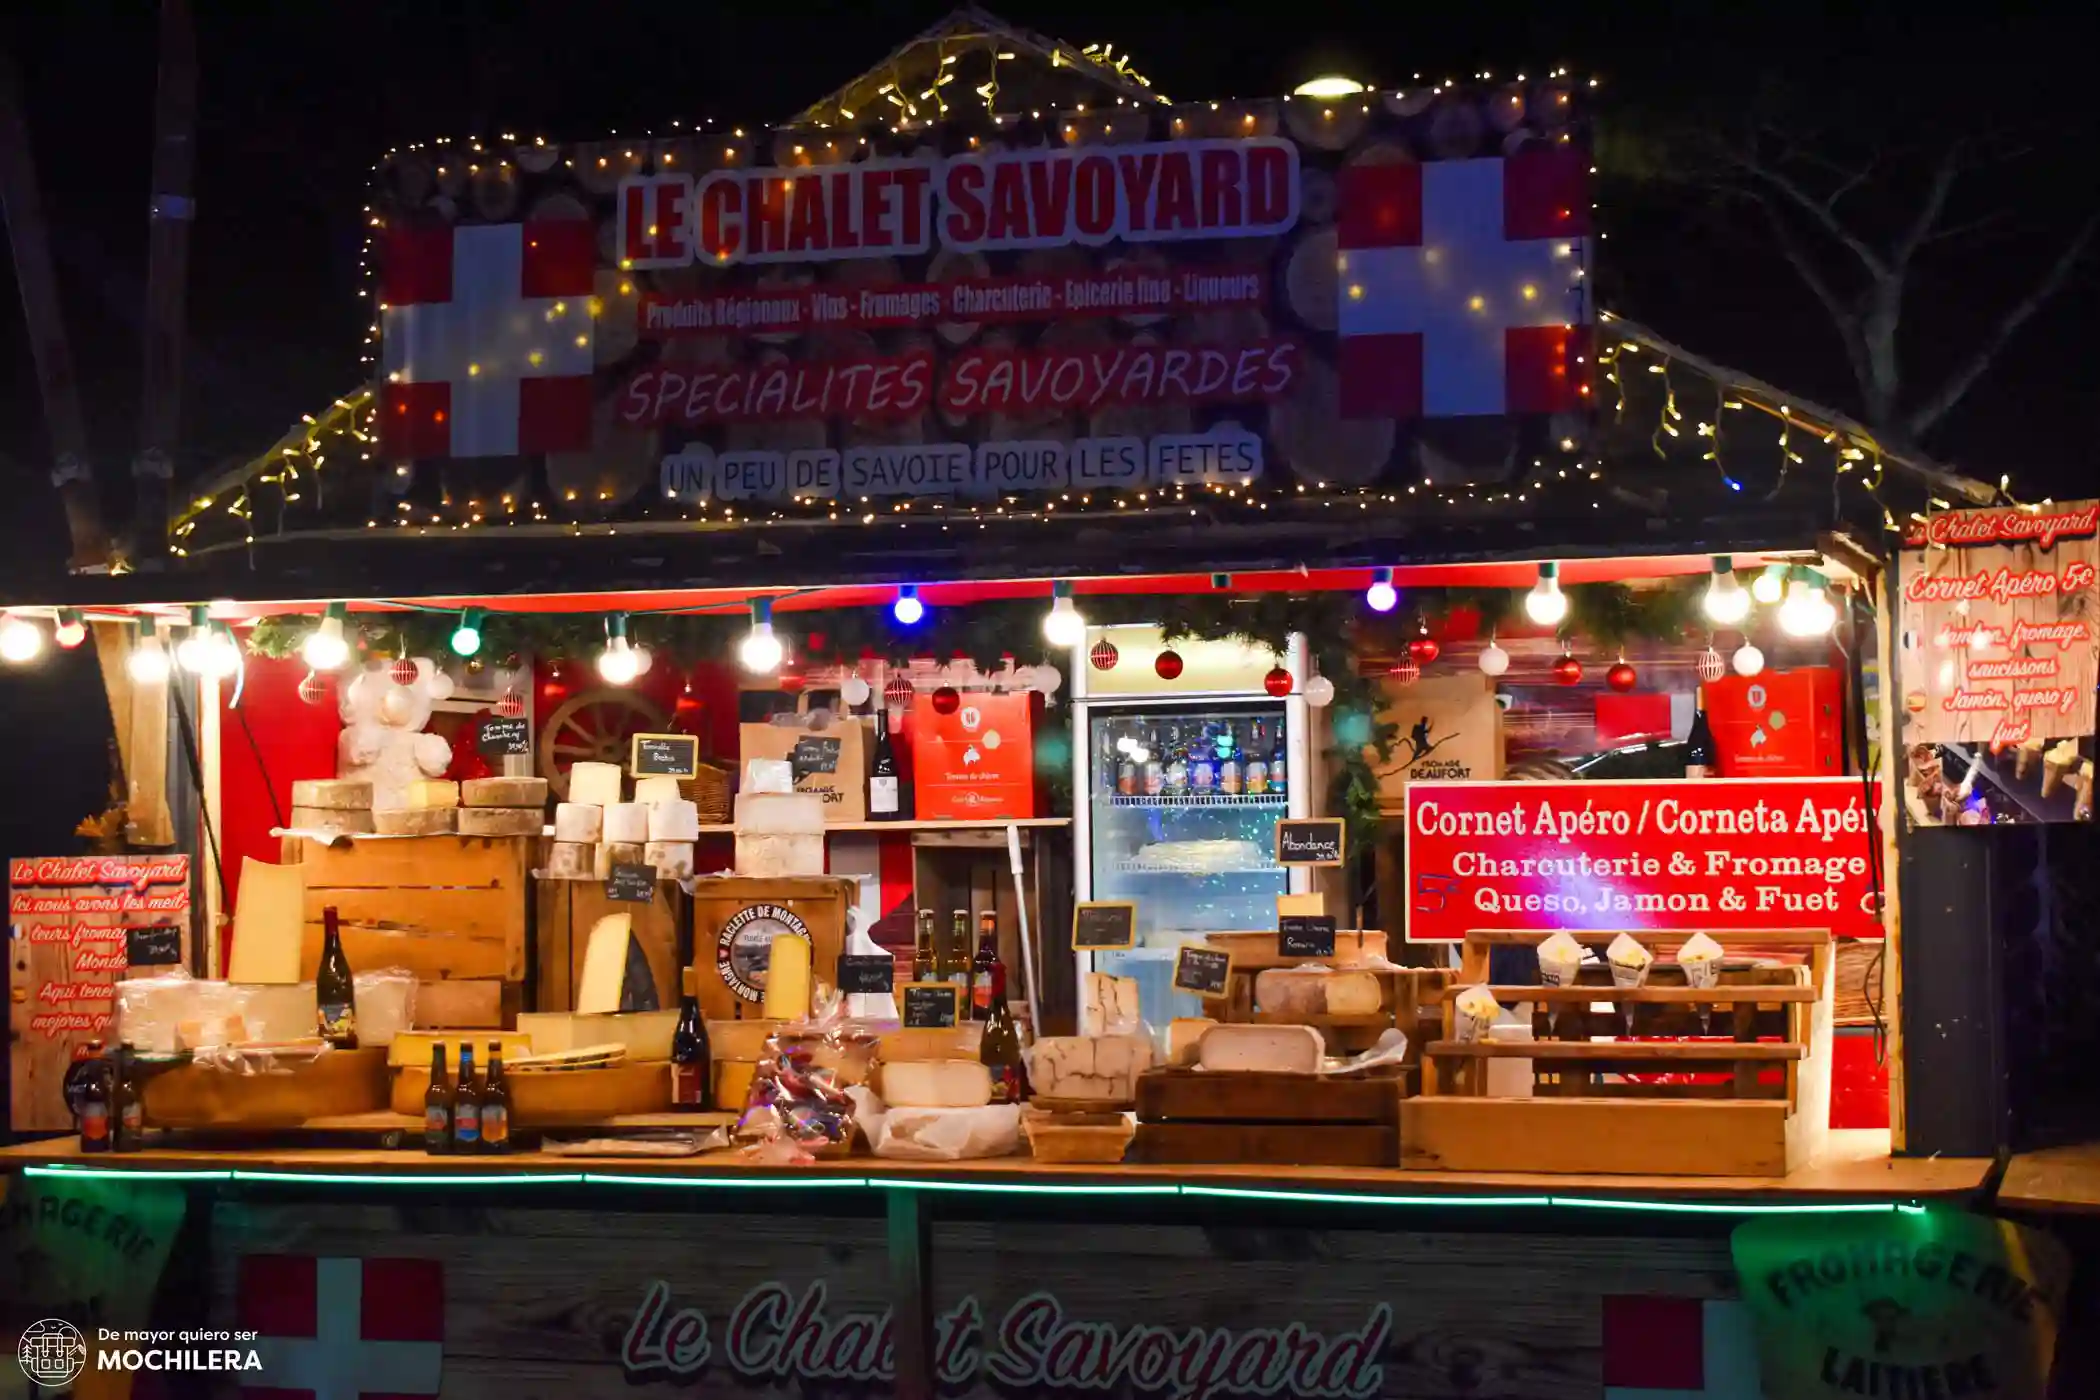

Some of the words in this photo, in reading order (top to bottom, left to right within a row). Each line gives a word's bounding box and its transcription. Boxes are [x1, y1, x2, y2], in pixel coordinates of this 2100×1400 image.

[626, 183, 685, 259] LE
[702, 168, 931, 256] CHALET
[946, 147, 1289, 242] SAVOYARD
[647, 300, 713, 328] Produits
[715, 297, 800, 328] Régionaux
[811, 293, 850, 321] Vins
[860, 289, 940, 319] Fromages
[953, 282, 1052, 313] Charcuterie
[1183, 271, 1259, 305] Liqueurs
[622, 358, 929, 422] SPECIALITES
[950, 343, 1296, 406] SAVOYARDES
[669, 462, 704, 492] UN
[725, 462, 776, 490] PEU
[796, 459, 833, 488] DE
[852, 454, 963, 487] SAVOIE
[985, 450, 1057, 482] POUR
[1081, 446, 1136, 477] LES
[1158, 442, 1255, 475] FETES
[1932, 514, 1997, 541] Chalet
[1908, 571, 1987, 600] Cornet
[1992, 570, 2057, 605] Apéro
[1969, 657, 2058, 677] saucissons
[2014, 690, 2060, 712] queso
[2062, 690, 2075, 713] y
[1992, 721, 2030, 748] fuet
[1410, 768, 1471, 779] BEAUFORT
[1417, 801, 1526, 836] Cornet
[1533, 799, 1631, 844] Apéro
[1636, 799, 1650, 835] /
[1656, 798, 1789, 835] Corneta
[1795, 796, 1880, 842] Apér
[1282, 831, 1336, 851] Abondance
[14, 862, 34, 881] Le
[38, 861, 97, 881] Chalet
[101, 858, 185, 889] Savoyard
[1452, 851, 1660, 877] Charcuterie
[1668, 851, 1697, 876] &
[1704, 850, 1867, 883] Fromage
[35, 899, 71, 911] nous
[75, 898, 120, 911] avons
[123, 893, 145, 909] les
[1474, 887, 1588, 915] Queso,
[1594, 887, 1711, 912] Jamon
[1718, 886, 1747, 911] &
[1755, 886, 1840, 911] Fuet
[32, 924, 70, 941] leurs
[719, 907, 757, 946] RACLETTE
[757, 905, 771, 918] DE
[32, 1014, 90, 1038] mejores
[622, 1279, 712, 1373] Le
[982, 1291, 1393, 1400] Savoyard
